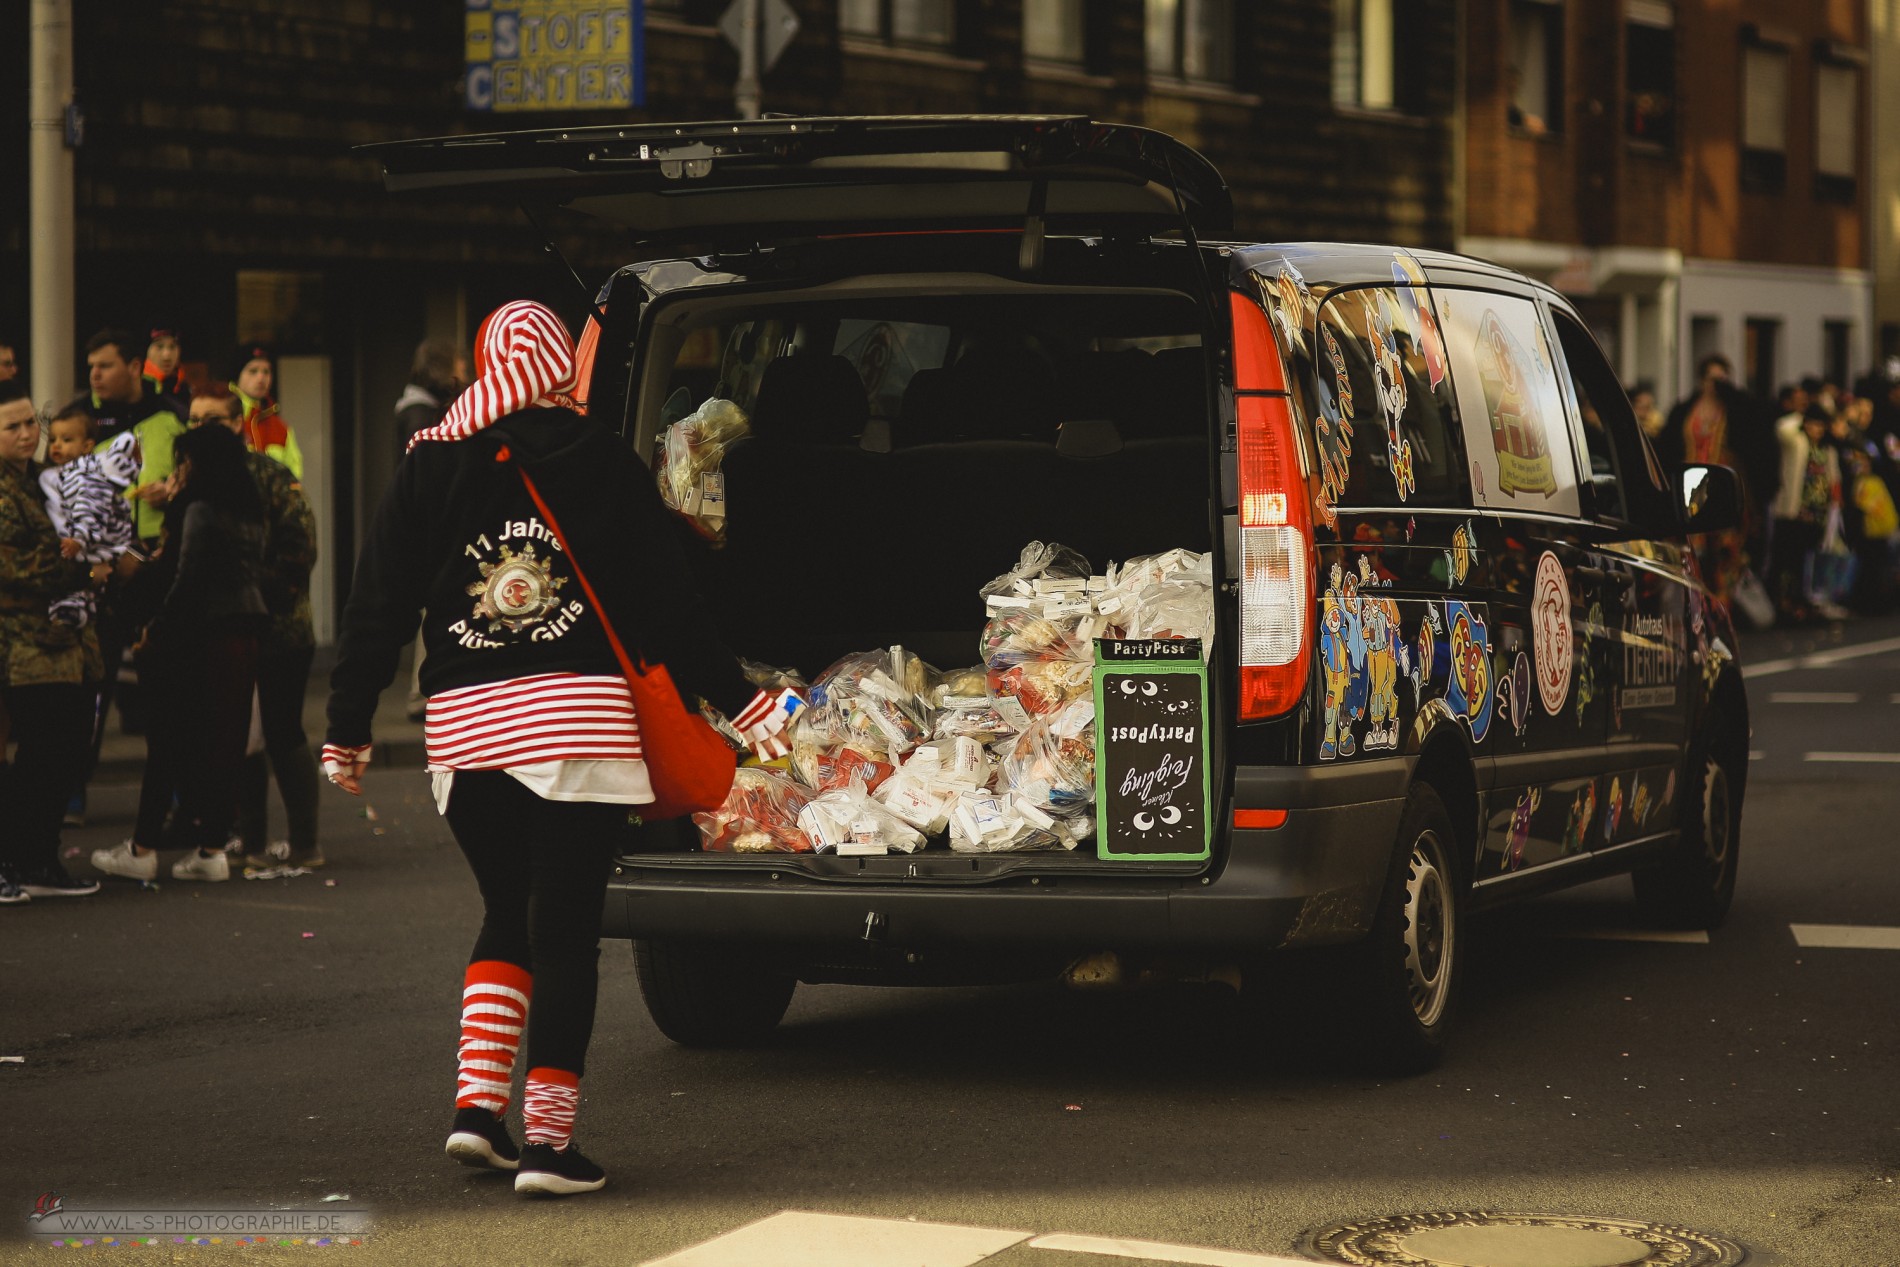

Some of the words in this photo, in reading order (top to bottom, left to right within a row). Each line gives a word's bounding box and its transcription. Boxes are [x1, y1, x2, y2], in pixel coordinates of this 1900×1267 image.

[467, 63, 628, 108] CENTER
[465, 533, 493, 560] 11
[530, 600, 584, 642] Girls
[1635, 613, 1663, 636] Autohaus
[1114, 642, 1186, 657] PartyPost
[1111, 723, 1194, 743] PartyPost
[1120, 753, 1193, 799] Feigling
[1141, 789, 1174, 807] Kleiner
